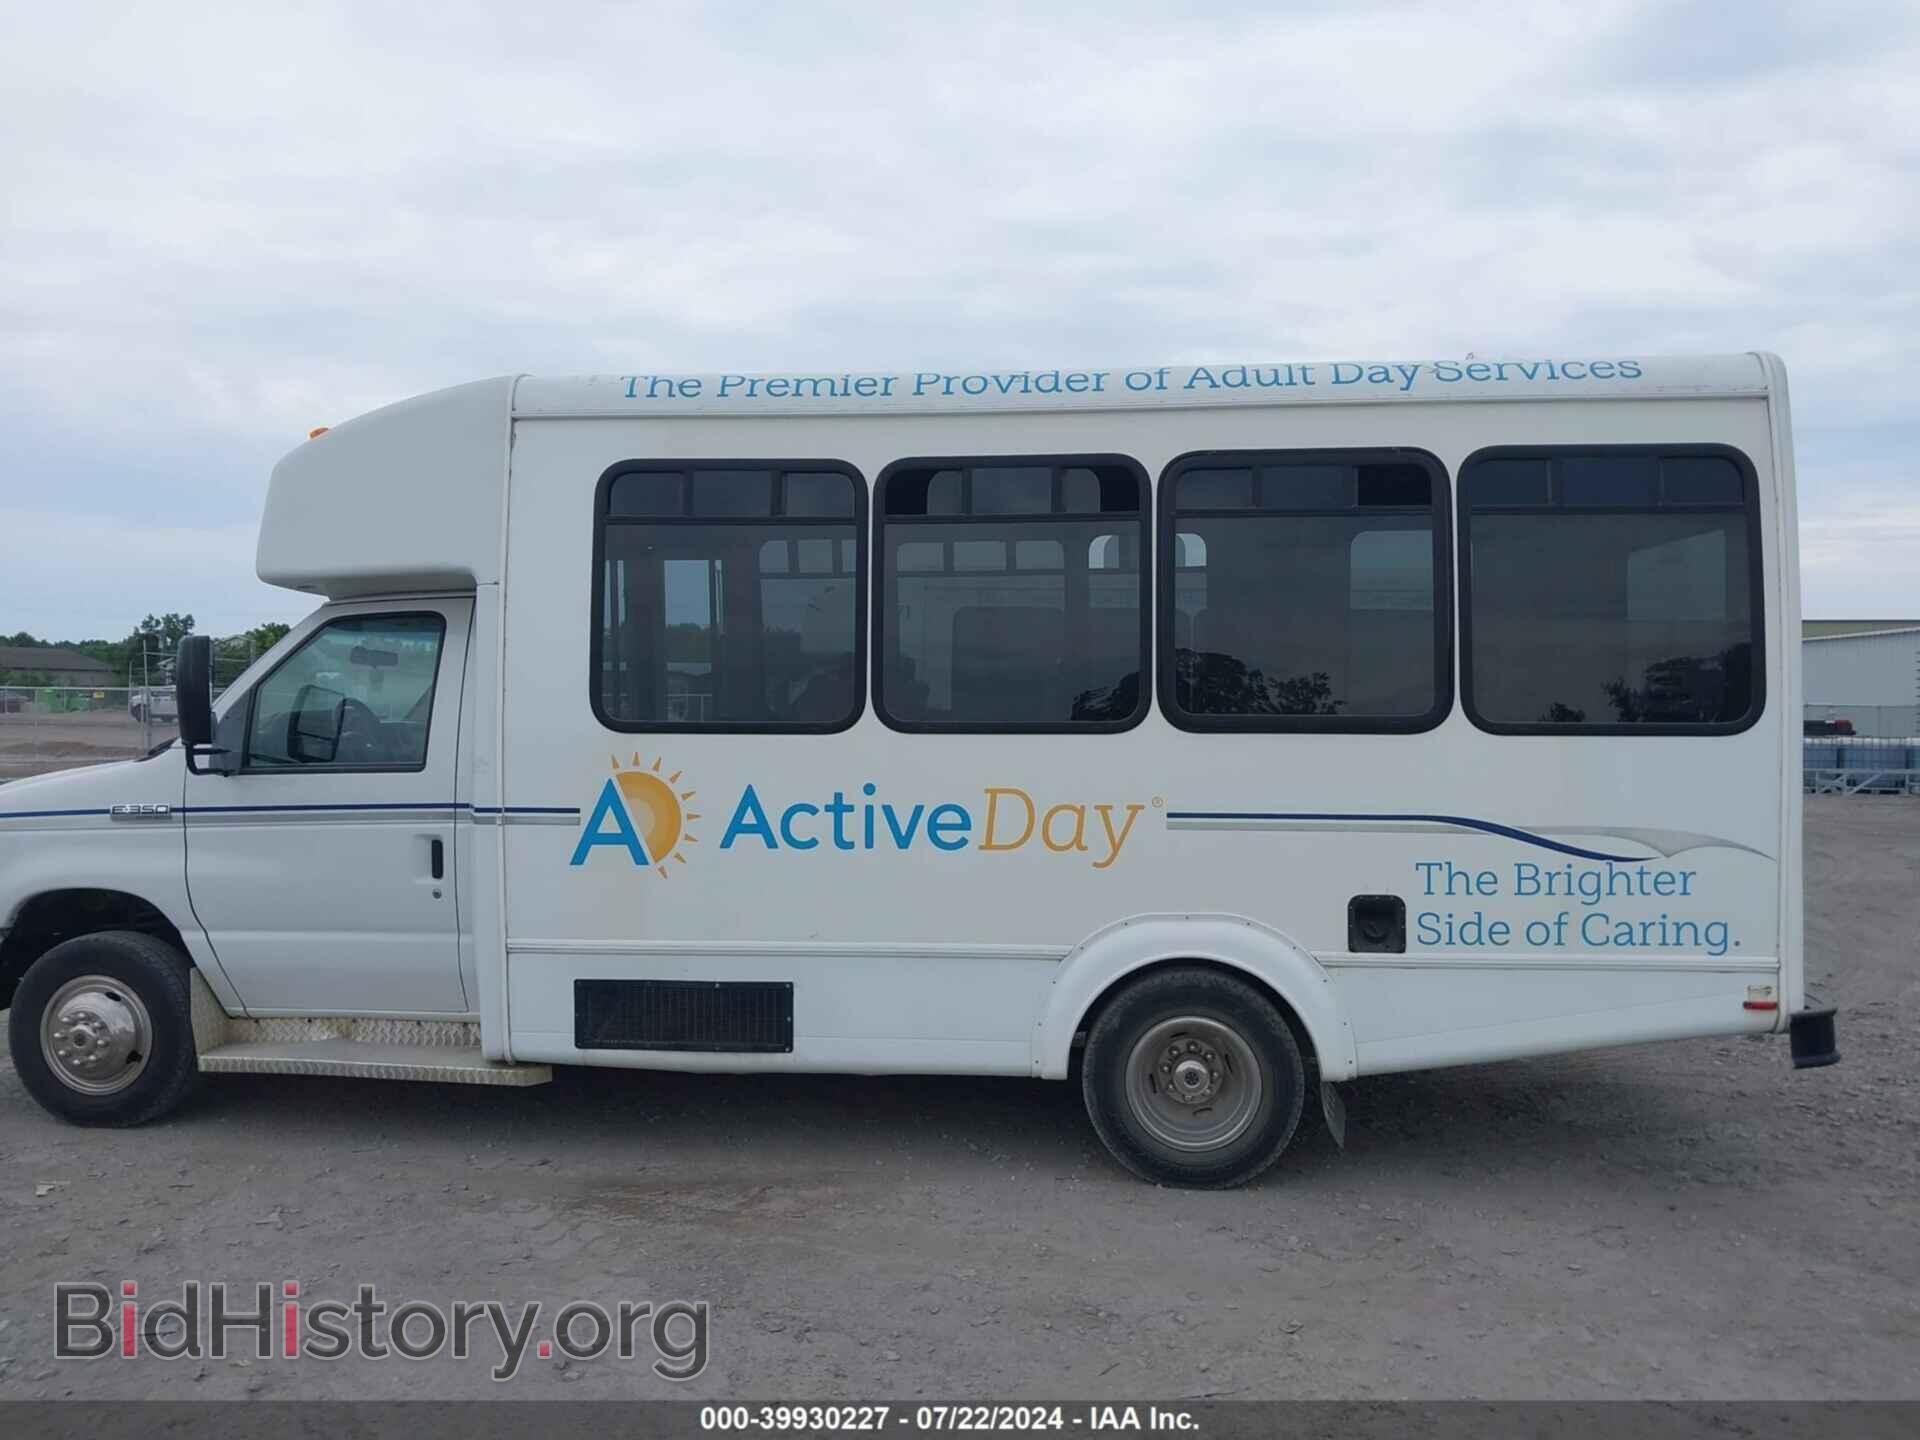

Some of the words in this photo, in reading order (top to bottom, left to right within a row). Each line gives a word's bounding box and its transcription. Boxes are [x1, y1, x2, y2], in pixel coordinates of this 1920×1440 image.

[621, 376, 702, 398] The
[717, 375, 899, 398] Premier
[912, 370, 1111, 396] Provider
[1125, 368, 1171, 391] of
[1183, 365, 1316, 390] Adult
[1330, 362, 1423, 391] Day
[1434, 358, 1643, 382] Services
[1415, 862, 1499, 897] The
[1513, 861, 1697, 905] Brighter
[1416, 911, 1511, 946] Side
[1525, 911, 1569, 946] of
[1581, 913, 1742, 956] Caring.
